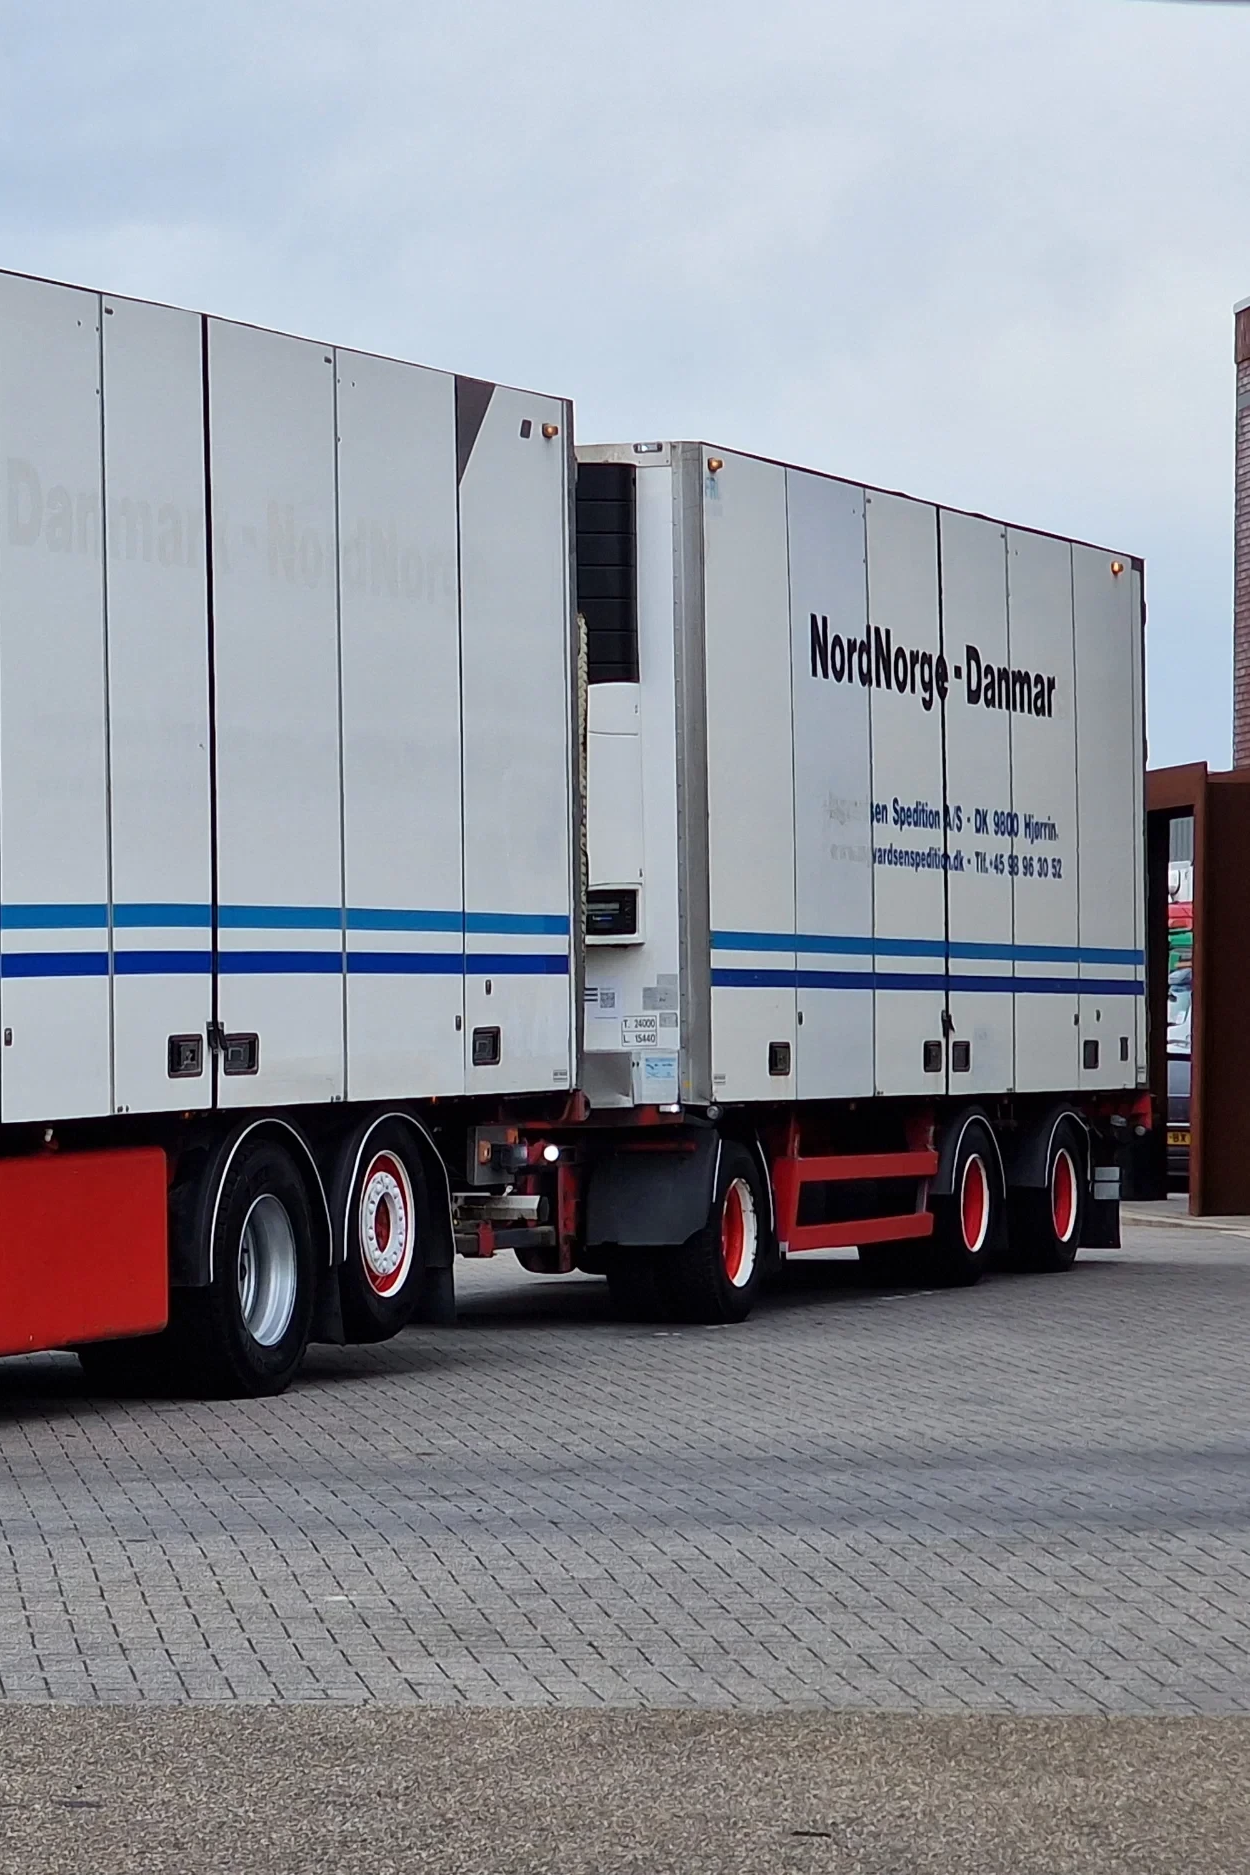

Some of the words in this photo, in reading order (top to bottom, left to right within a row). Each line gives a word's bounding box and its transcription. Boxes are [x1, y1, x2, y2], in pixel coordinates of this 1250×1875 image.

[810, 613, 949, 712] NordNorge
[892, 796, 941, 832] Spedition
[974, 808, 989, 836] DK
[993, 809, 1020, 839] 9800
[1022, 855, 1035, 879] 96
[1037, 856, 1049, 879] 30
[1051, 857, 1063, 880] 52
[634, 1018, 656, 1029] 24000
[634, 1033, 656, 1044] 15440
